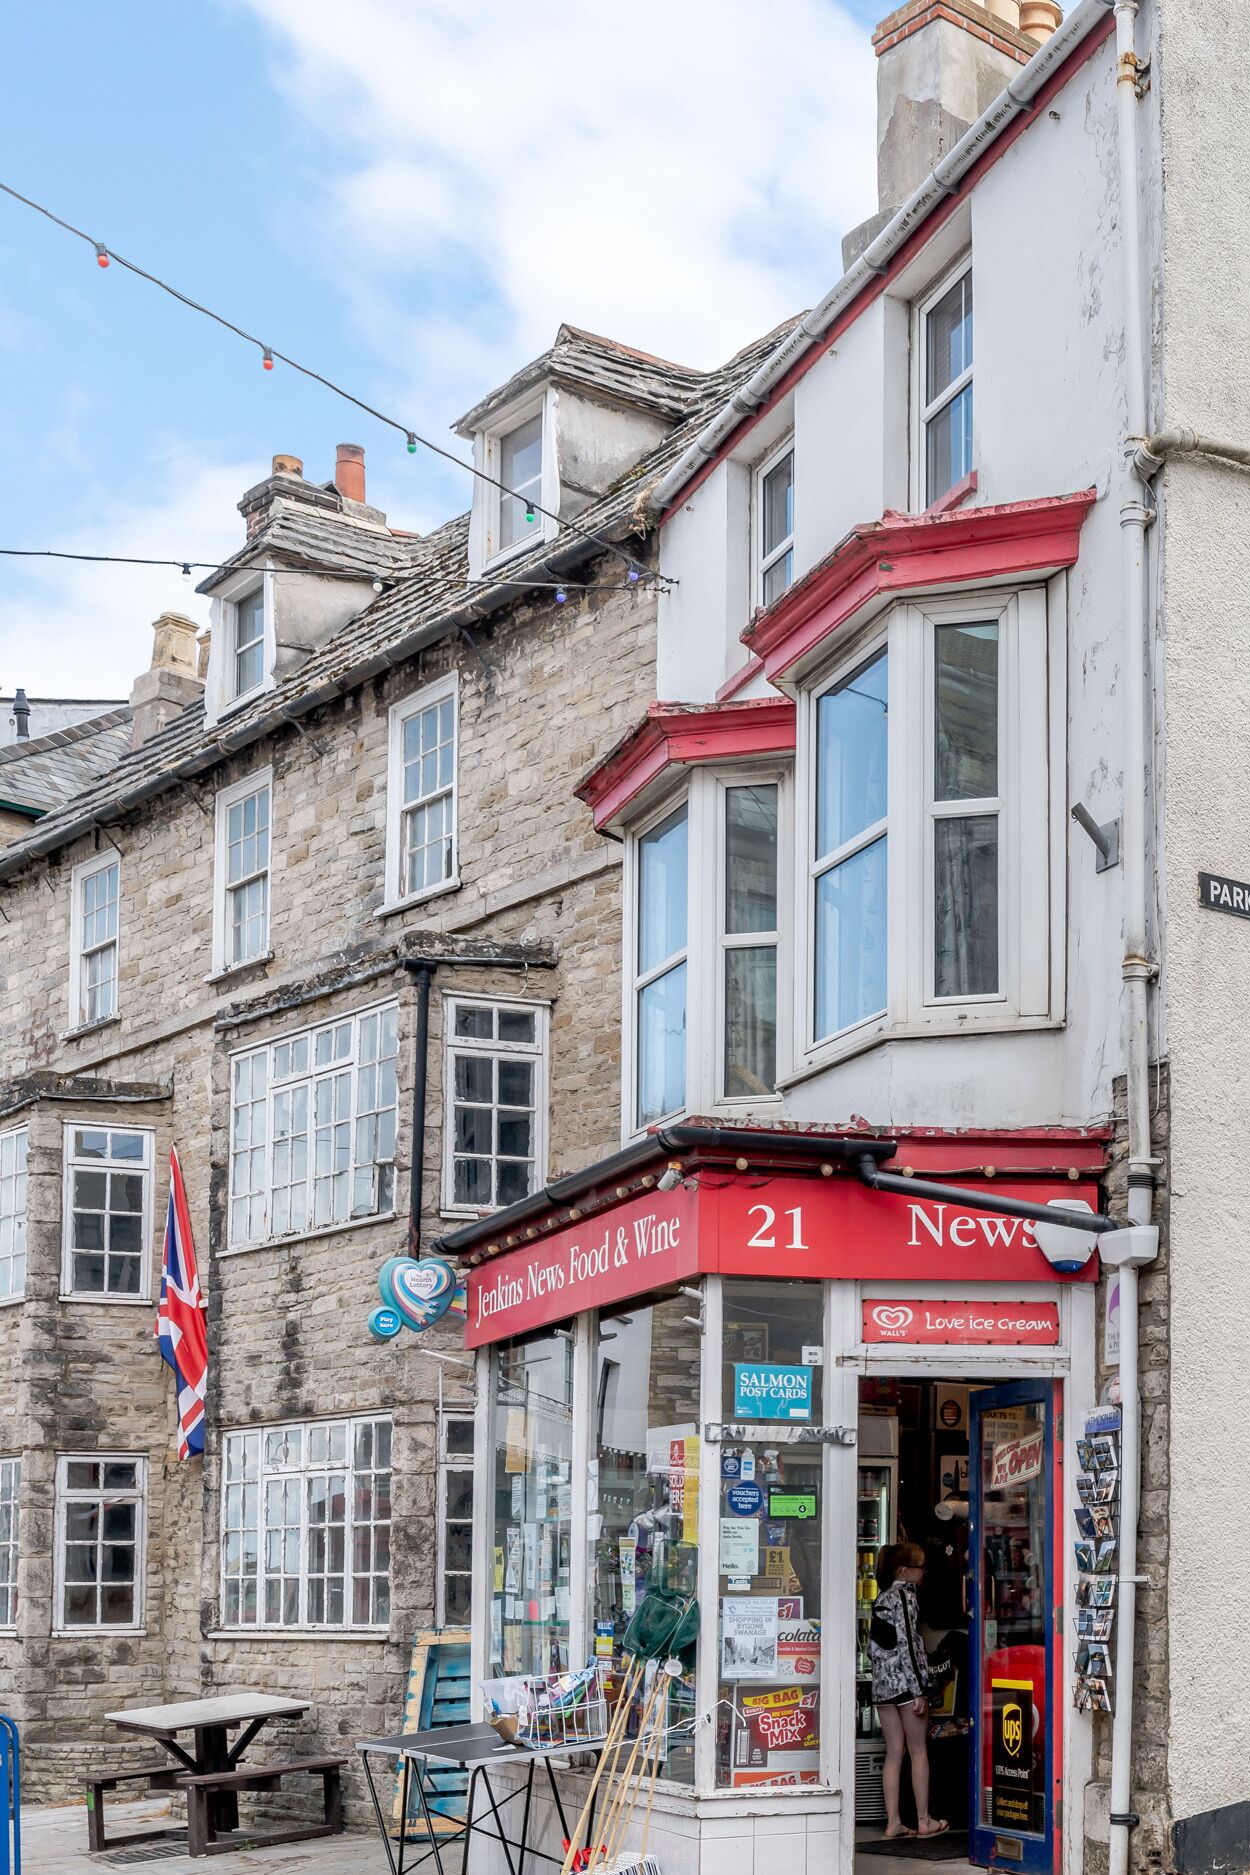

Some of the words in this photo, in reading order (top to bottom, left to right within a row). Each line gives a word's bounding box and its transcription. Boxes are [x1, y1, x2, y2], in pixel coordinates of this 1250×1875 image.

[746, 1204, 809, 1250] 21
[907, 1204, 1039, 1248] News
[474, 1276, 524, 1329] Jenkins
[526, 1261, 566, 1301] News
[568, 1230, 610, 1286] Food
[613, 1226, 630, 1268] &
[632, 1213, 681, 1258] Wine
[410, 1282, 433, 1290] Lottery
[925, 1311, 965, 1332] Love
[968, 1314, 996, 1331] ice
[997, 1317, 1054, 1332] cream
[740, 1372, 808, 1389] SALMON
[740, 1386, 769, 1398] POST
[770, 1387, 808, 1399] CARDS
[1008, 1439, 1041, 1476] OPEN
[731, 1496, 759, 1504] accepted
[732, 1489, 760, 1497] vouchers
[738, 1502, 752, 1510] here
[769, 1550, 784, 1564] £1
[752, 1696, 769, 1706] BIG
[772, 1689, 799, 1704] BAG
[801, 1691, 818, 1708] £1
[760, 1711, 806, 1732] Snack
[1004, 1719, 1021, 1748] ups
[995, 1765, 1004, 1775] UPS
[1004, 1766, 1018, 1778] Access
